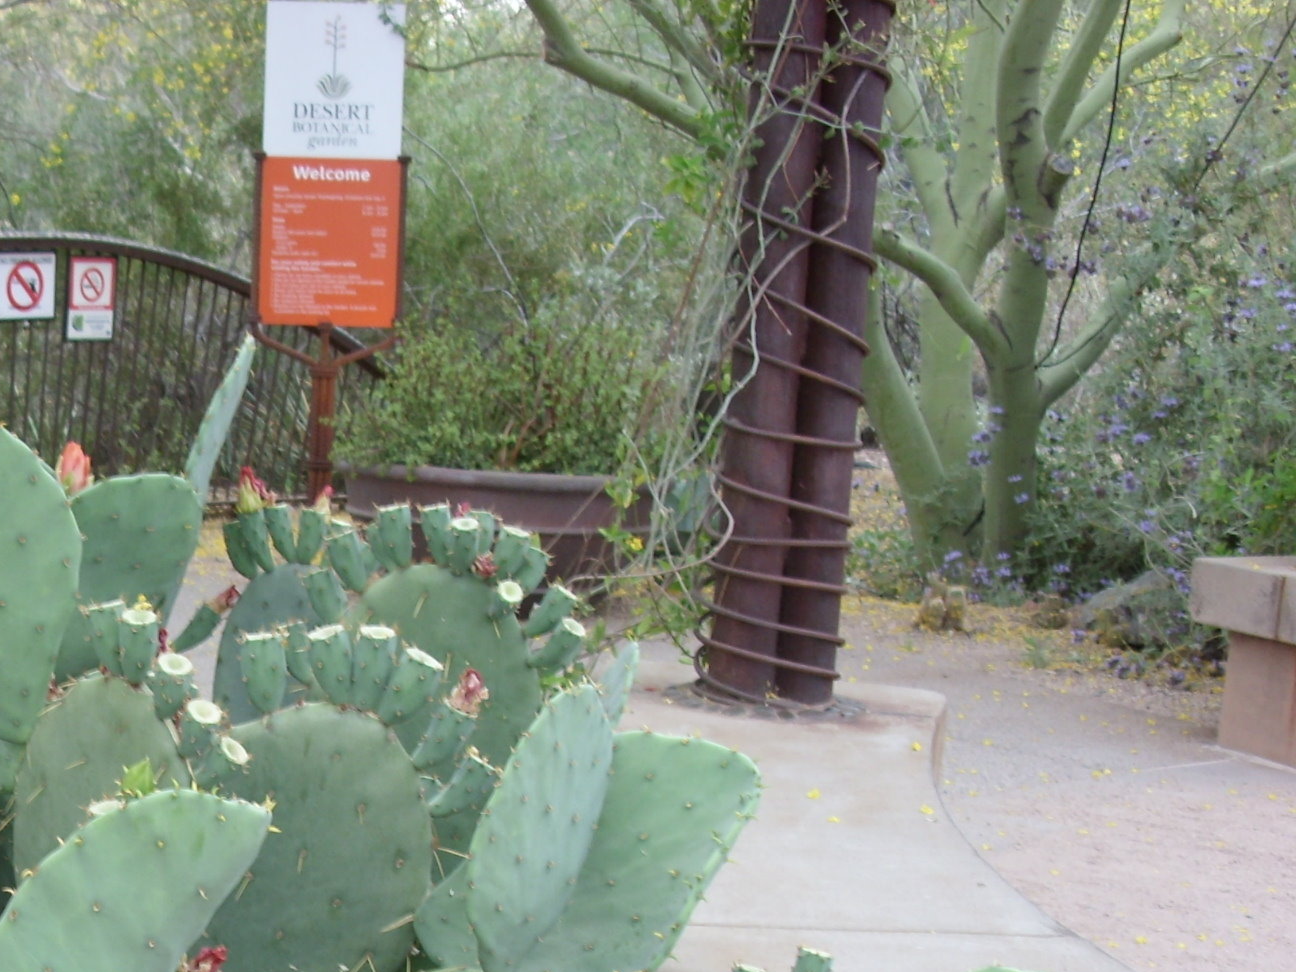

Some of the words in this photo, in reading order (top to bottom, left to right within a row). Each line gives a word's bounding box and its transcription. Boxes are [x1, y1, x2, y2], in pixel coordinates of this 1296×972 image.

[294, 103, 374, 119] DESERT
[293, 121, 374, 135] BOTANICAL
[293, 165, 371, 181] Welcome
